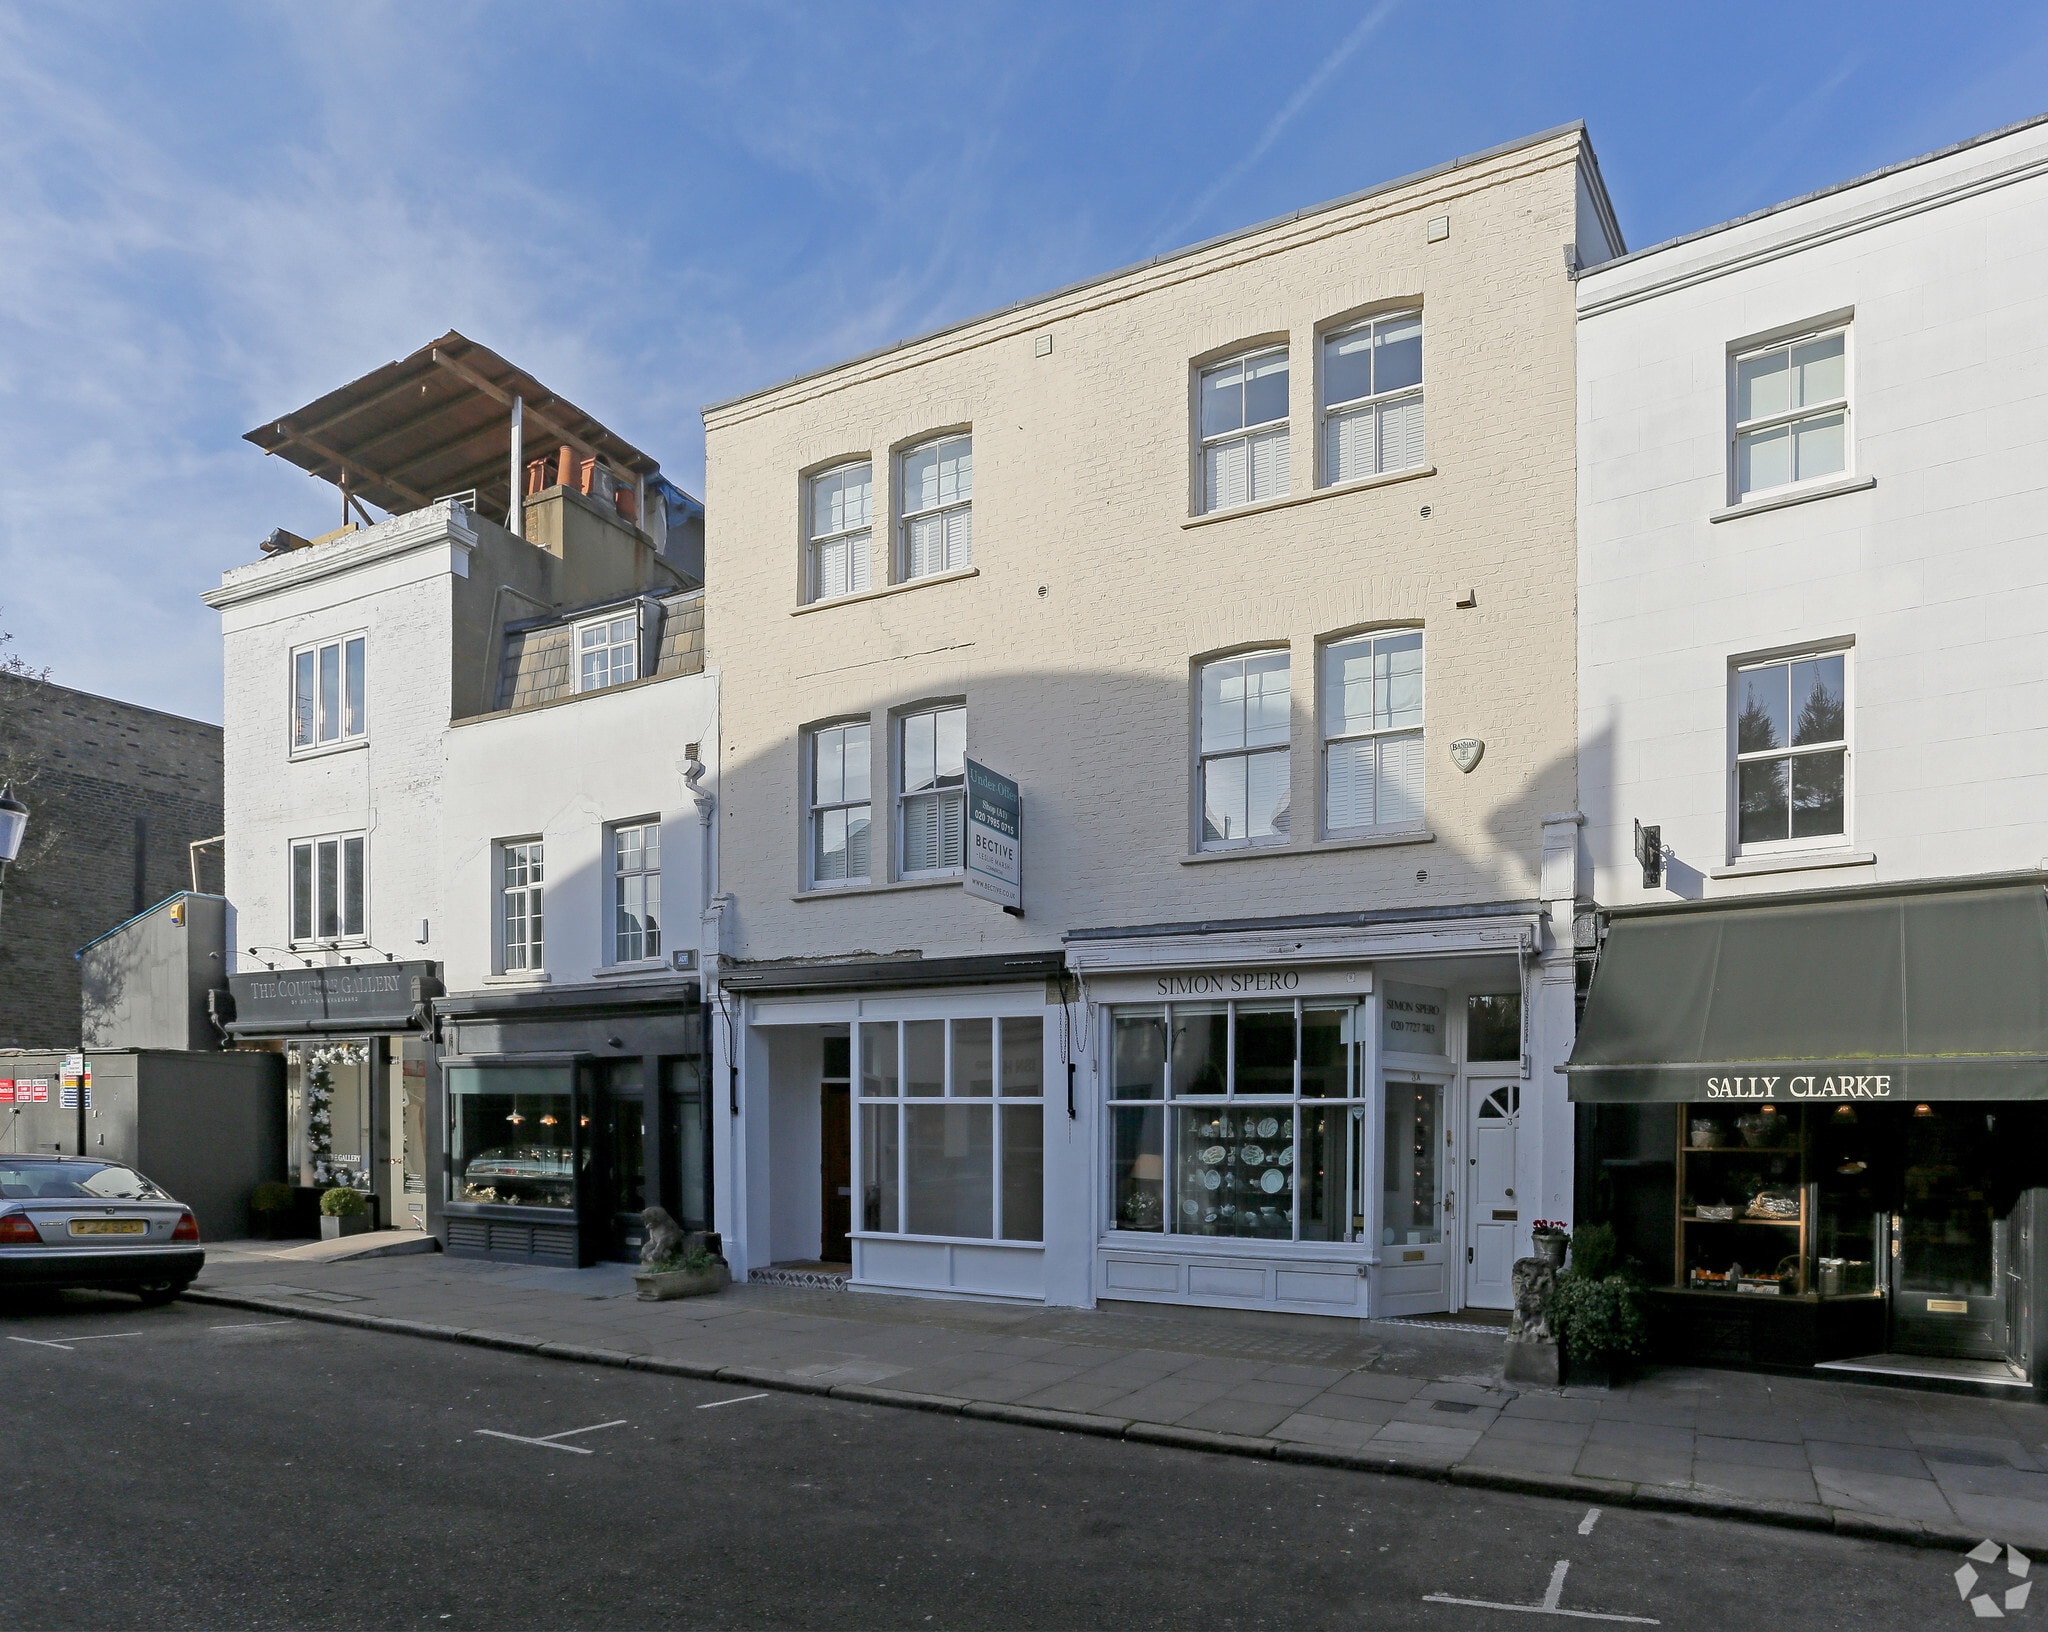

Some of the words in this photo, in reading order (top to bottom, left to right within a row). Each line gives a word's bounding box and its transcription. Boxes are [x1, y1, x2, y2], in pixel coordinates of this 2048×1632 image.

[970, 768, 996, 792] Under
[997, 782, 1018, 802] Offer
[982, 799, 996, 816] Shop
[974, 809, 986, 822] 020
[986, 814, 1000, 829] 7985
[1000, 821, 1015, 835] 0715
[975, 833, 1014, 861] BECTIVE
[250, 982, 277, 999] THE
[278, 980, 339, 998] COUTURE
[341, 975, 400, 994] GALLERY
[1157, 975, 1224, 996] SIMON
[1230, 970, 1299, 993] SPERO
[1386, 999, 1414, 1012] SIMON
[1415, 1003, 1440, 1016] SPERO
[1390, 1020, 1404, 1032] 020
[1405, 1021, 1421, 1033] 7727
[1707, 1076, 1781, 1098] SALLY
[1789, 1075, 1891, 1099] CLARKE
[337, 1153, 361, 1163] GALLERY
